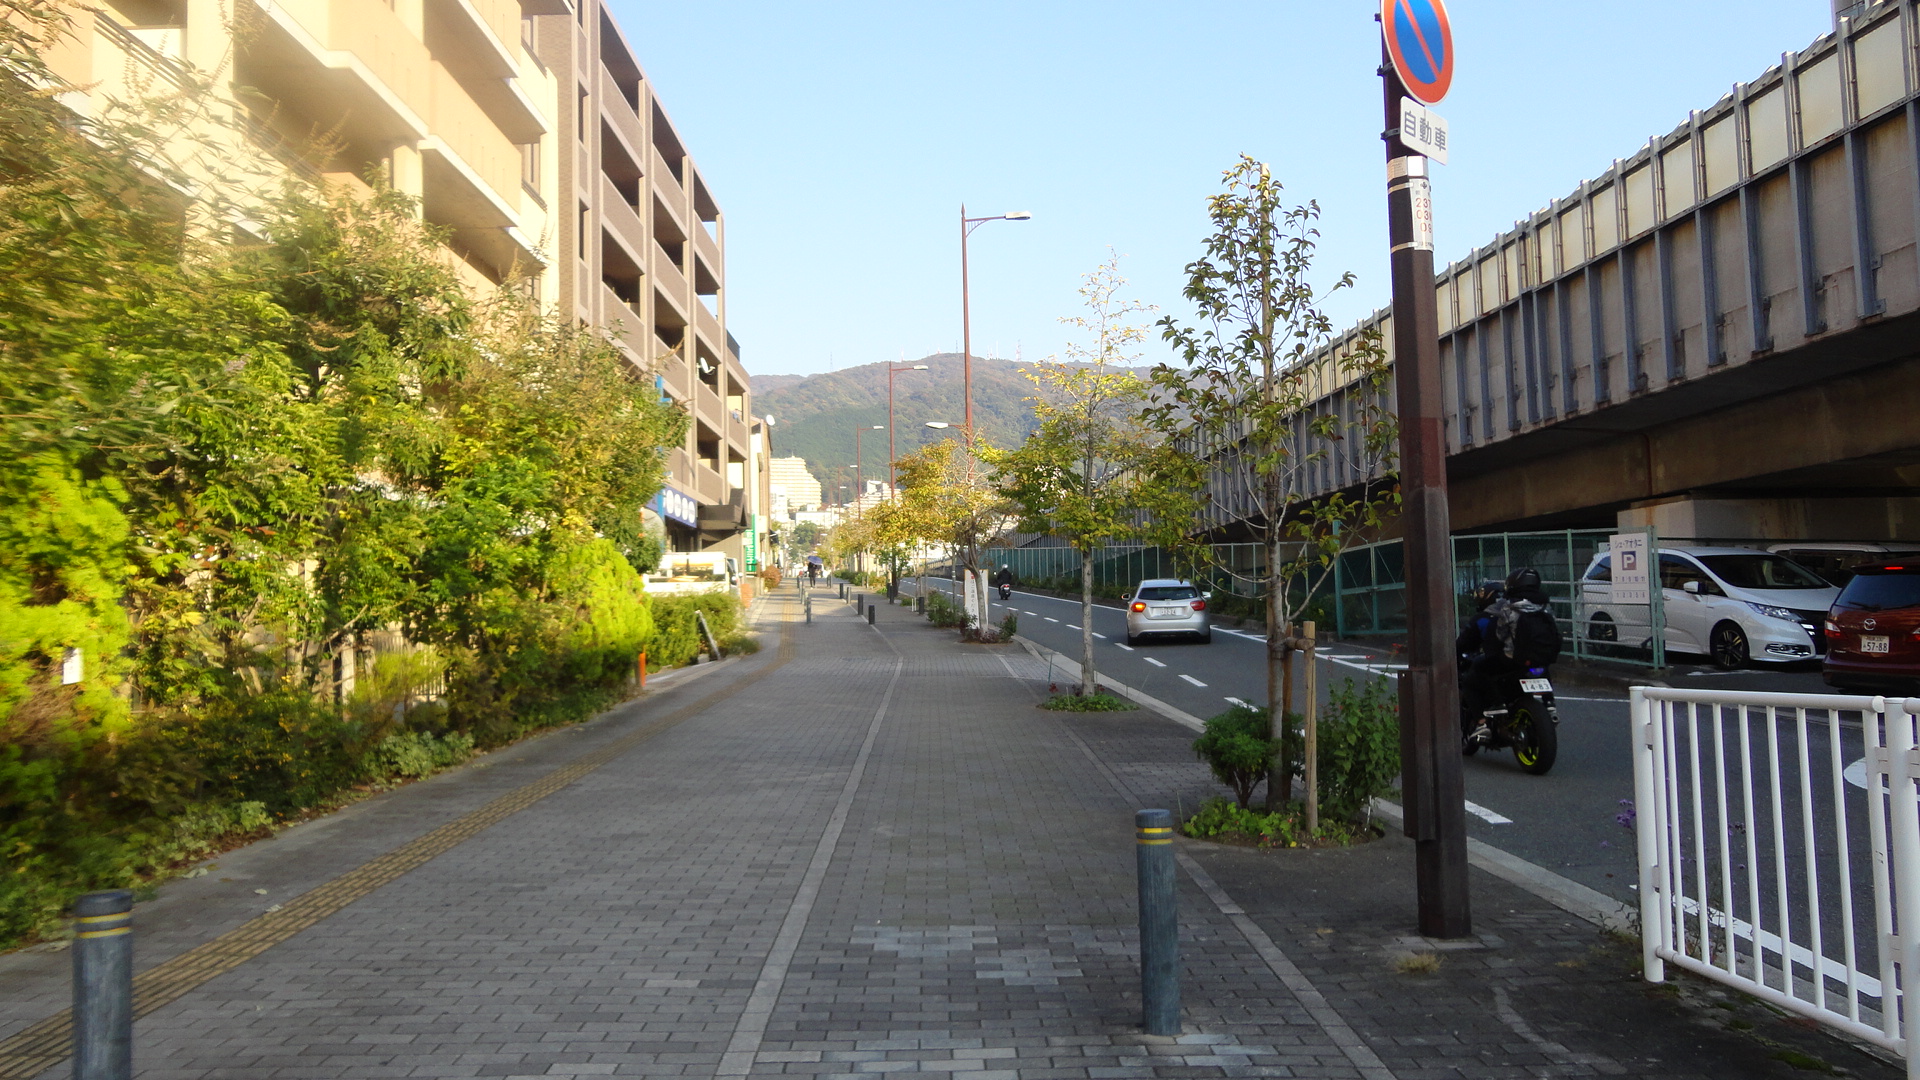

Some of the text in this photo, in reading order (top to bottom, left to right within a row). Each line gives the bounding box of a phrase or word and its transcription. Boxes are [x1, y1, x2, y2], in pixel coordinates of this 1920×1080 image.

[1404, 110, 1446, 151] 自動車
[1623, 554, 1635, 569] P
[1867, 642, 1888, 651] 57-88
